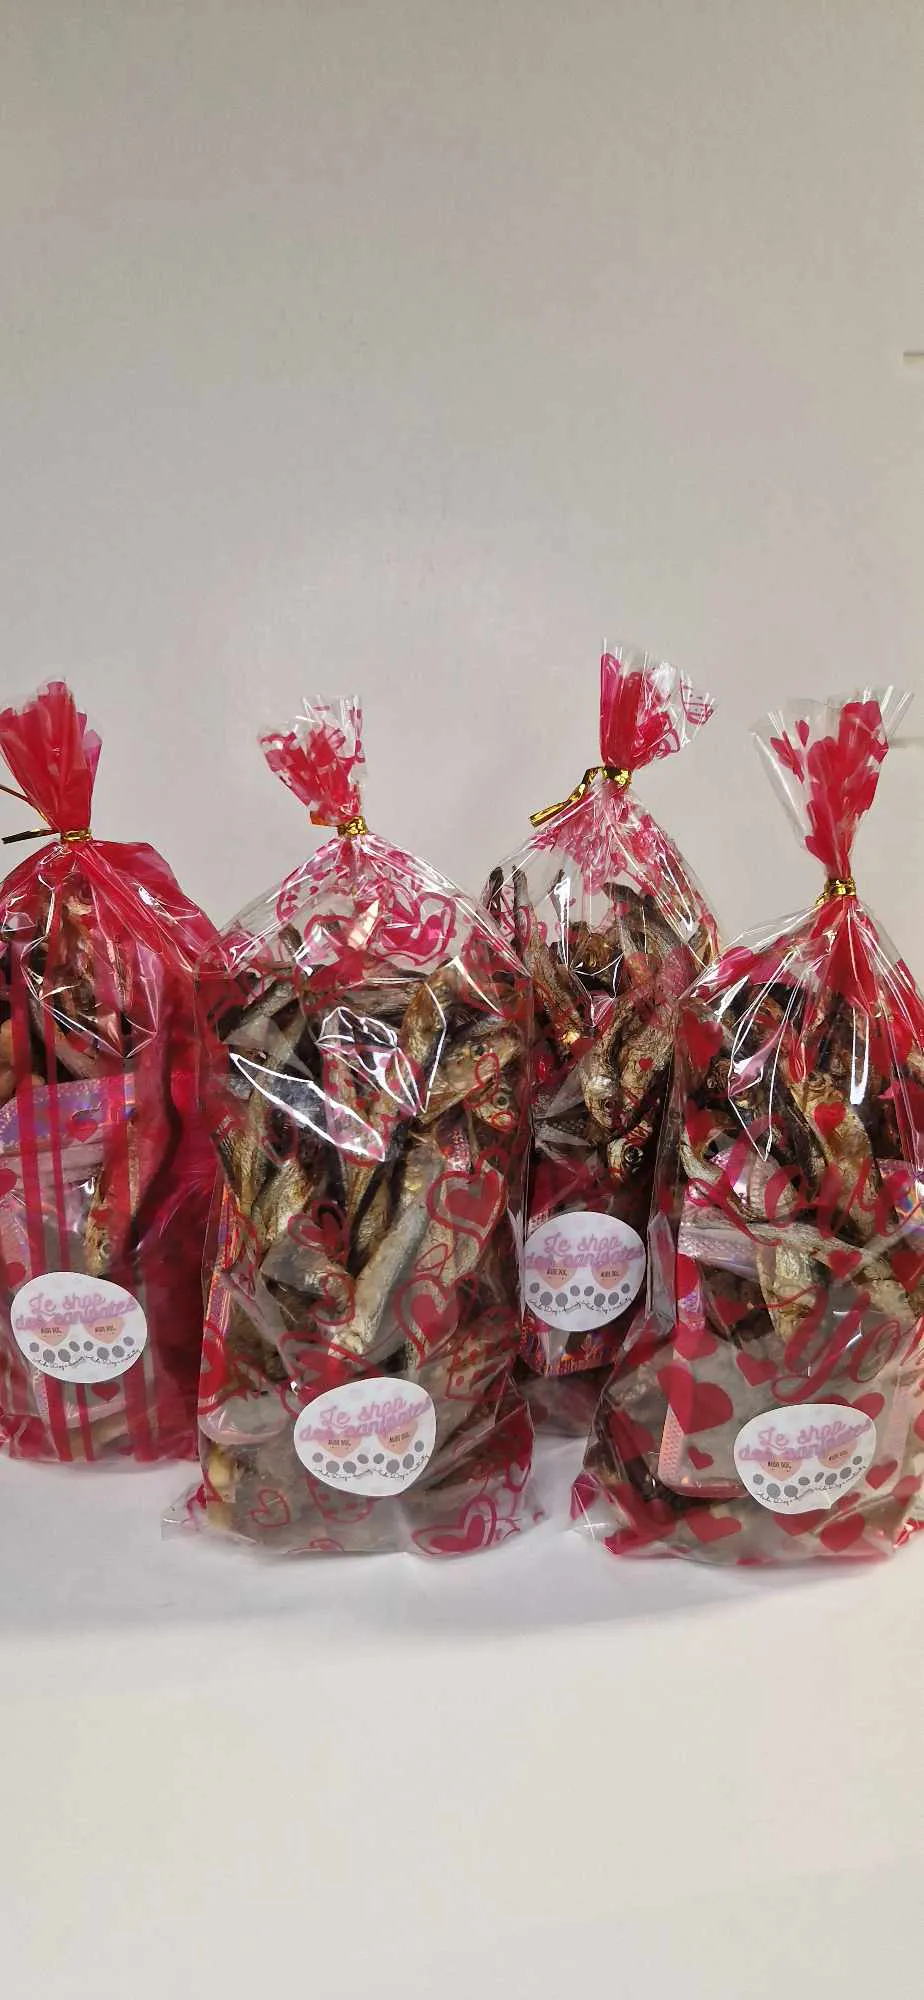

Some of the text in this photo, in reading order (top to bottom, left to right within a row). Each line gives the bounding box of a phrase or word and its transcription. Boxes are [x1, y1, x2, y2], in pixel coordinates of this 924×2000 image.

[576, 1233, 623, 1254] shop
[61, 1292, 107, 1314] shop
[356, 1396, 408, 1423] shop
[796, 1420, 847, 1446] shop
